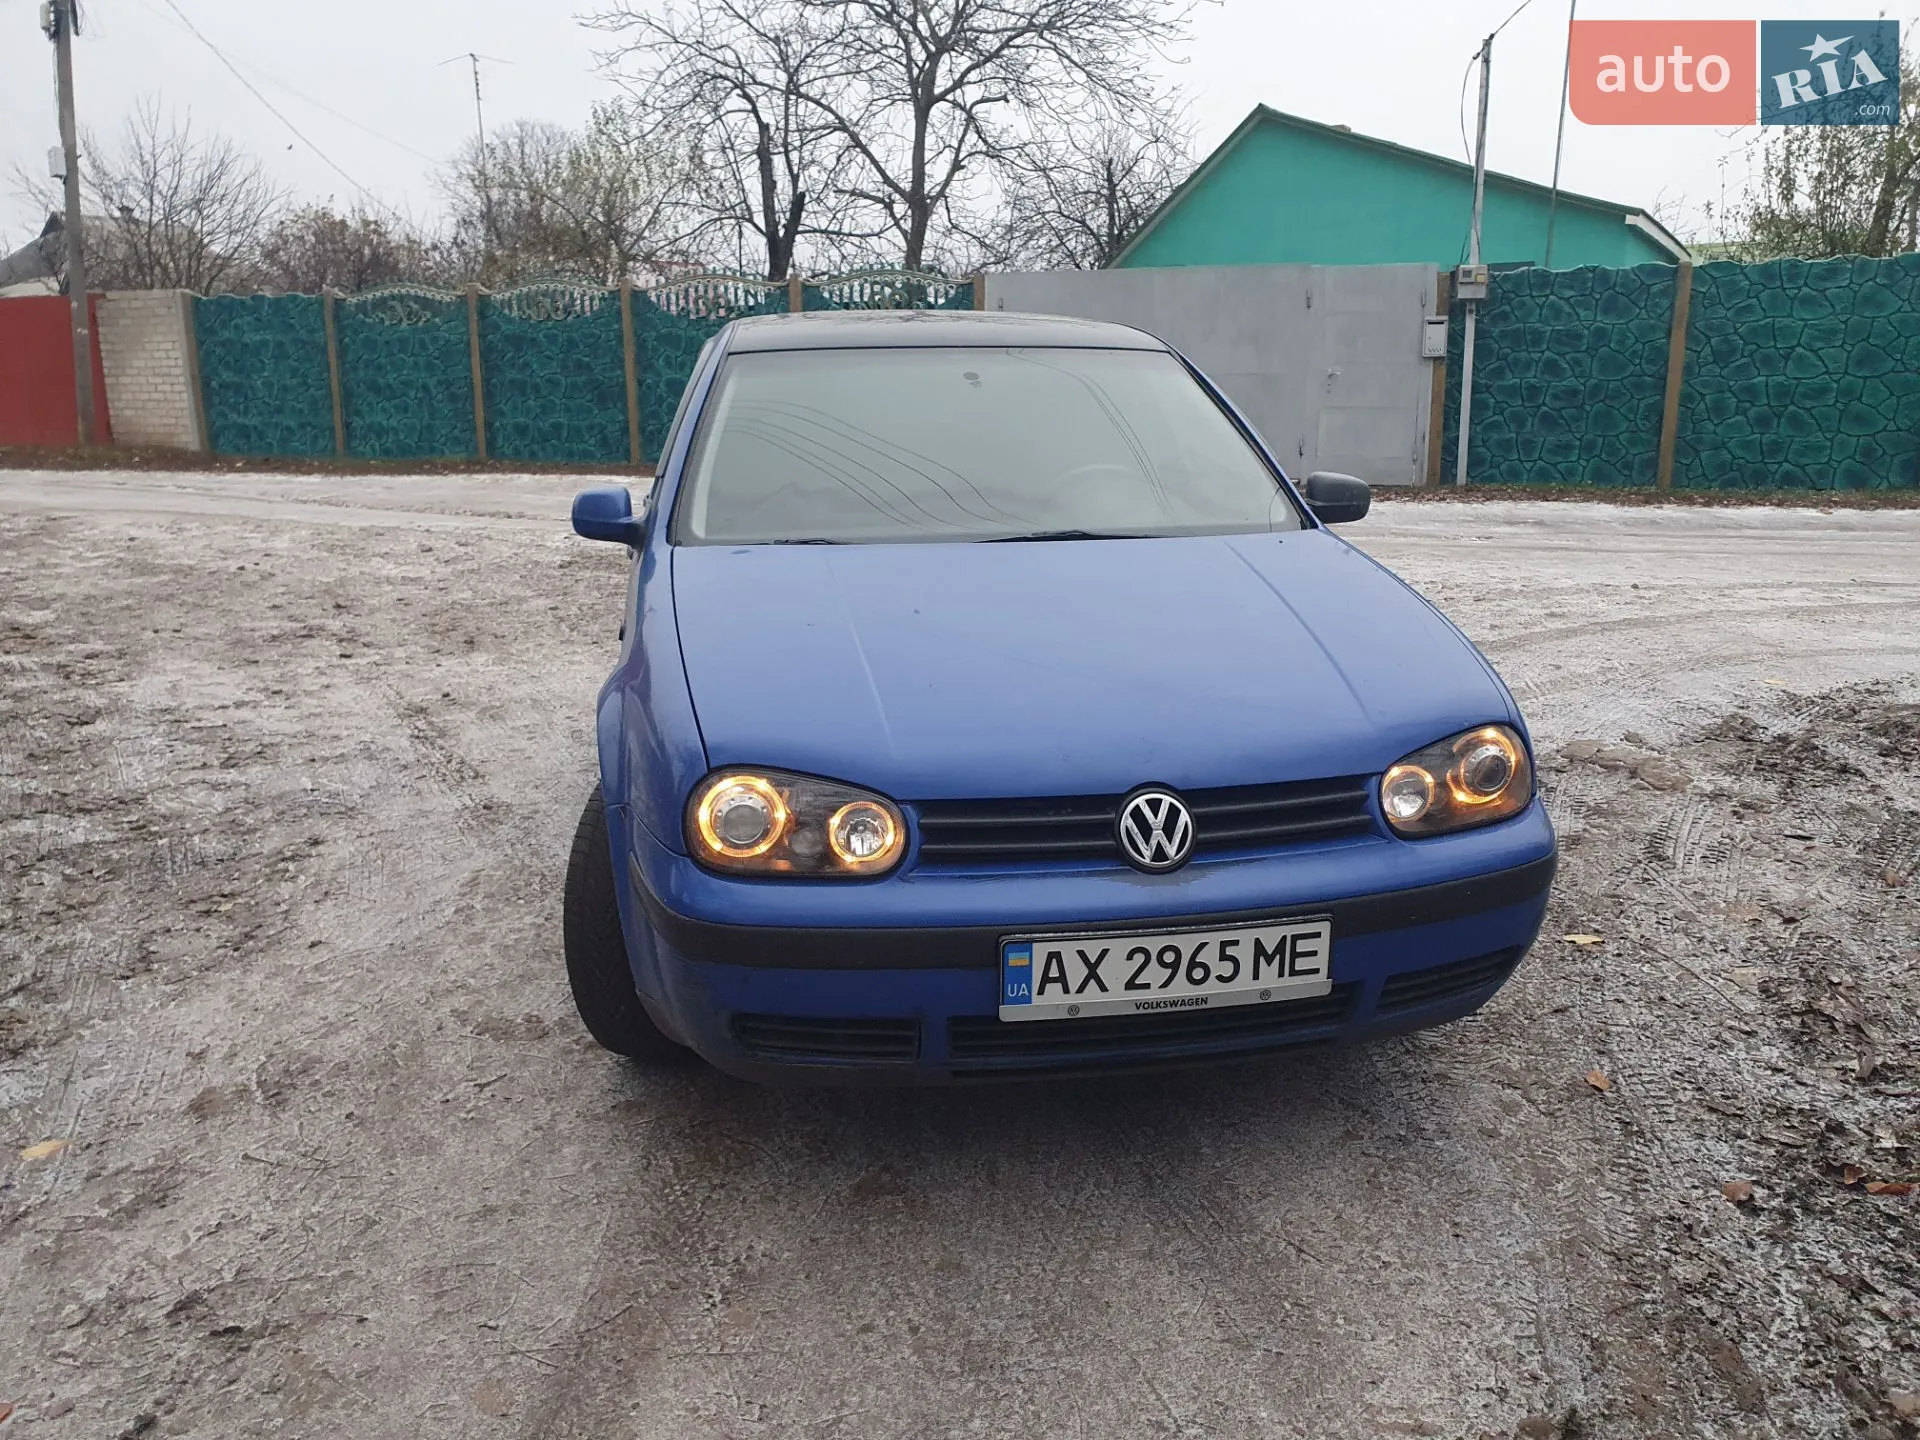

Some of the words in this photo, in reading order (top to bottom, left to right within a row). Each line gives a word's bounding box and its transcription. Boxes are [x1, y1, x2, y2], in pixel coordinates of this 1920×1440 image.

[1036, 948, 1110, 996] AX
[1124, 939, 1241, 991] 2965
[1252, 931, 1323, 981] ME
[1007, 984, 1029, 997] UA
[1134, 997, 1209, 1011] VOLKSWAGEN
